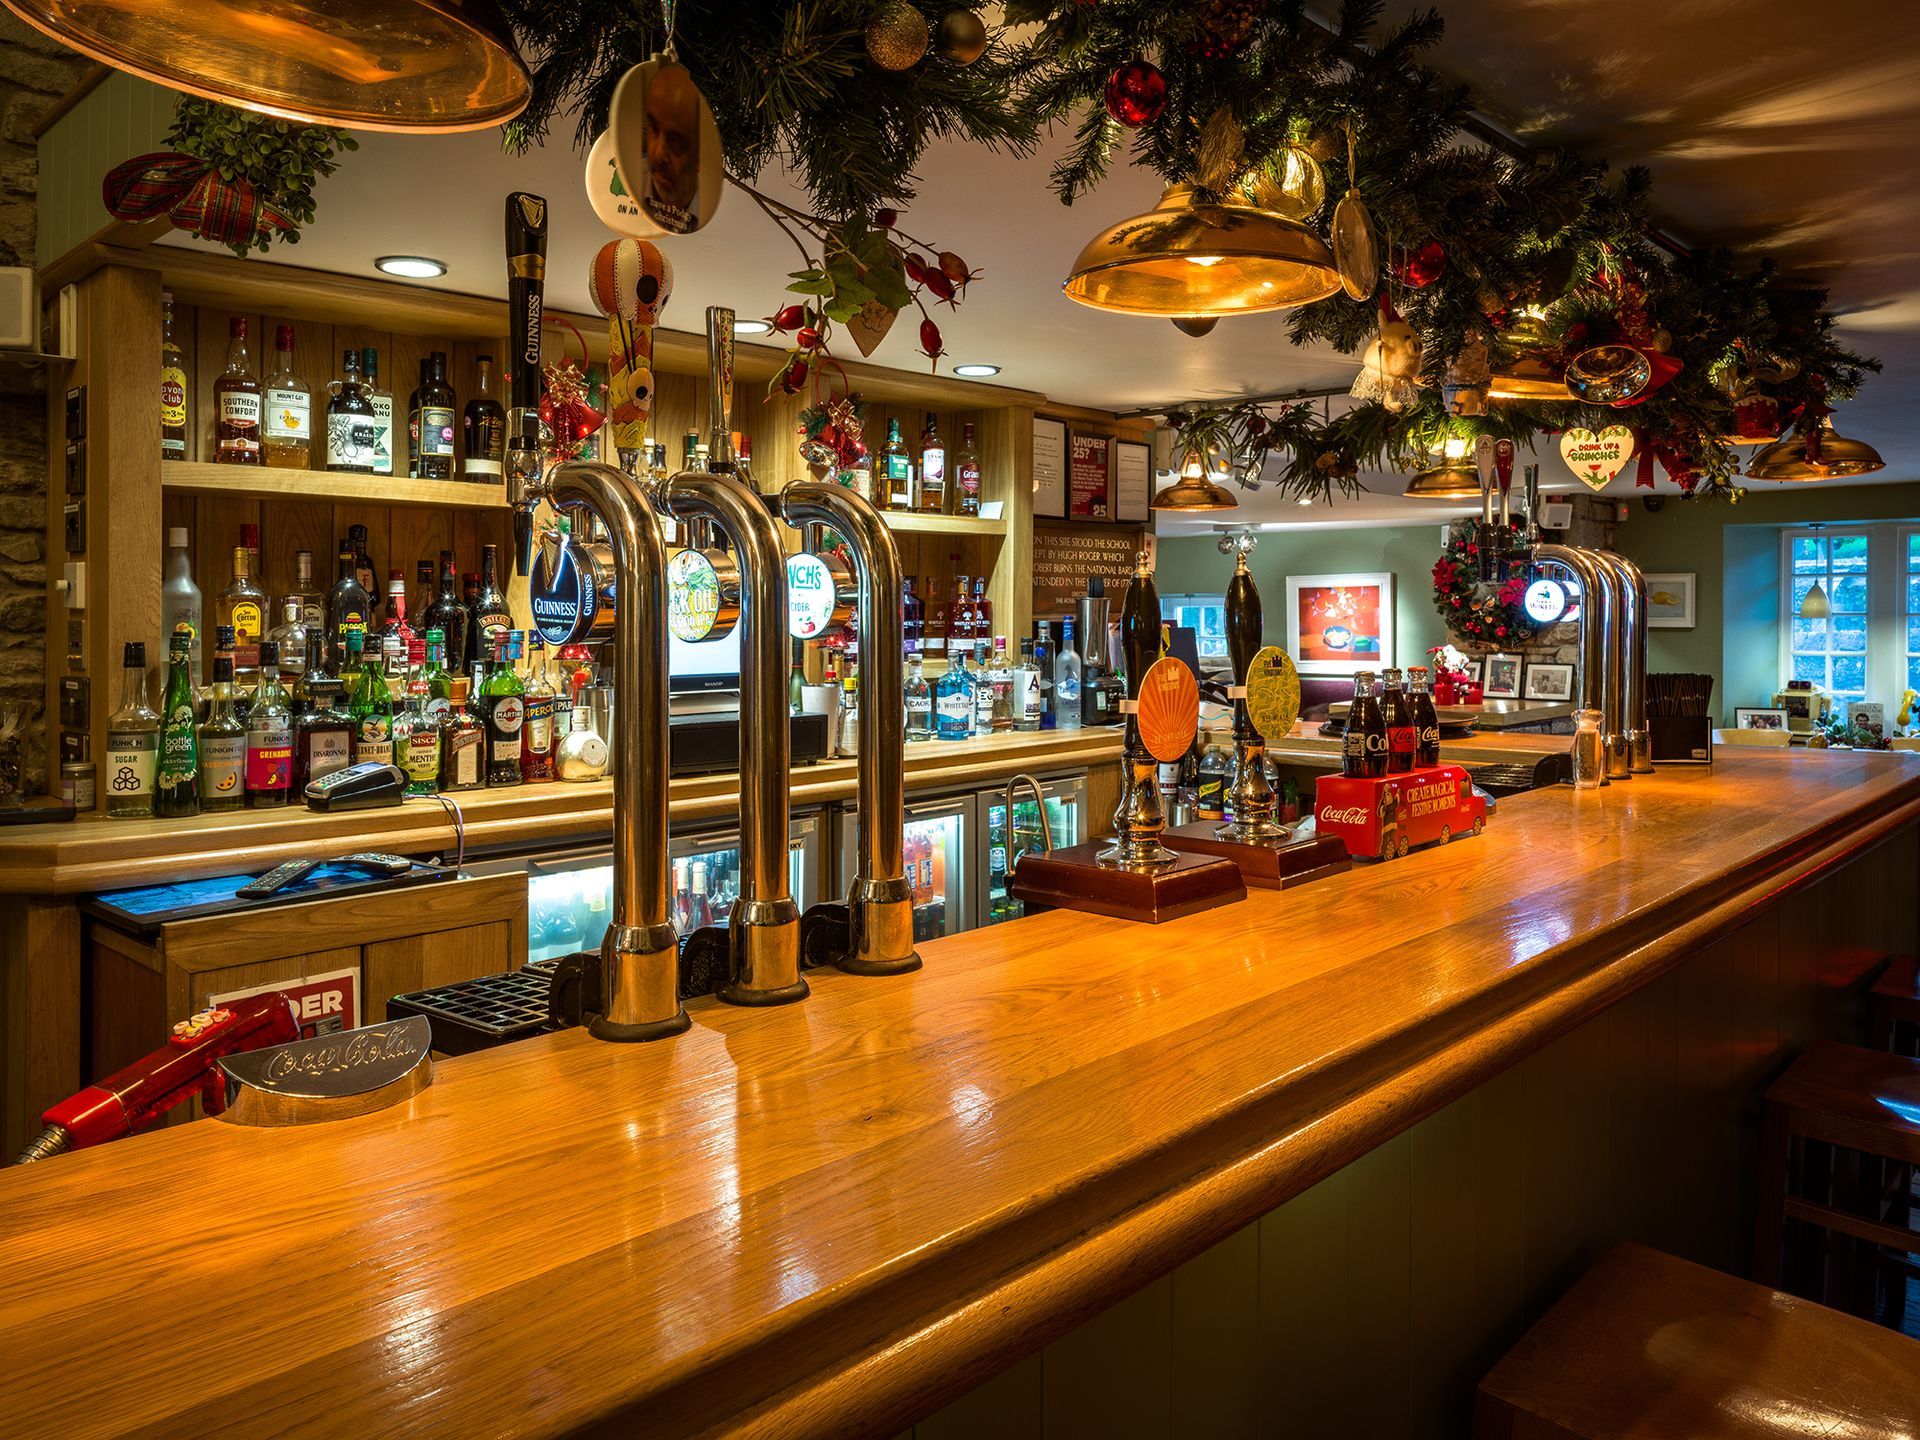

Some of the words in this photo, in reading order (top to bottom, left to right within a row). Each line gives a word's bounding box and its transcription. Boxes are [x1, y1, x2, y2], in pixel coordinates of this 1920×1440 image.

[617, 204, 628, 214] ON
[525, 294, 540, 364] GUINNESS
[162, 394, 182, 404] Club
[224, 398, 258, 408] SOUTHERN
[225, 406, 256, 416] COMFORT
[1073, 436, 1106, 450] UNDER
[1073, 448, 1090, 459] 25?
[1571, 450, 1620, 462] GRINCHES
[964, 470, 978, 478] Gran
[1093, 504, 1106, 516] 25
[1044, 536, 1058, 545] THIS
[1059, 537, 1070, 546] SITE
[1072, 538, 1094, 548] STOOD
[1094, 539, 1106, 548] THE
[1106, 540, 1131, 550] SCHOOL
[1048, 550, 1056, 560] BY
[1058, 550, 1078, 560] HUGH
[1102, 552, 1124, 562] WHICH
[1074, 564, 1086, 574] THE
[1086, 565, 1116, 575] NATIONAL
[1118, 566, 1133, 575] BARD
[1032, 576, 1065, 586] ATTENDED
[1066, 577, 1073, 586] IN
[1074, 578, 1086, 586] THE
[1086, 578, 1110, 588] SER
[1112, 578, 1121, 588] OF
[584, 574, 593, 616] GUINNESS
[534, 598, 576, 616] GUINNESS
[790, 602, 810, 612] CIDER
[236, 614, 256, 622] Cuervo
[480, 615, 510, 627] BAILEYS
[112, 739, 142, 747] FUNKIN
[166, 736, 192, 746] bottle
[264, 736, 290, 744] FUNKIN
[166, 744, 192, 754] green
[204, 746, 234, 754] FUNKIN
[313, 750, 347, 758] DISARONNO
[114, 755, 138, 764] SUGAR
[260, 750, 292, 759] GRENADINE
[1406, 784, 1430, 802] CREATE
[1430, 780, 1456, 799] MAGICAL
[1412, 799, 1432, 818] FESTIVE
[1432, 794, 1456, 814] MOMENTS
[292, 988, 344, 1019] DER
